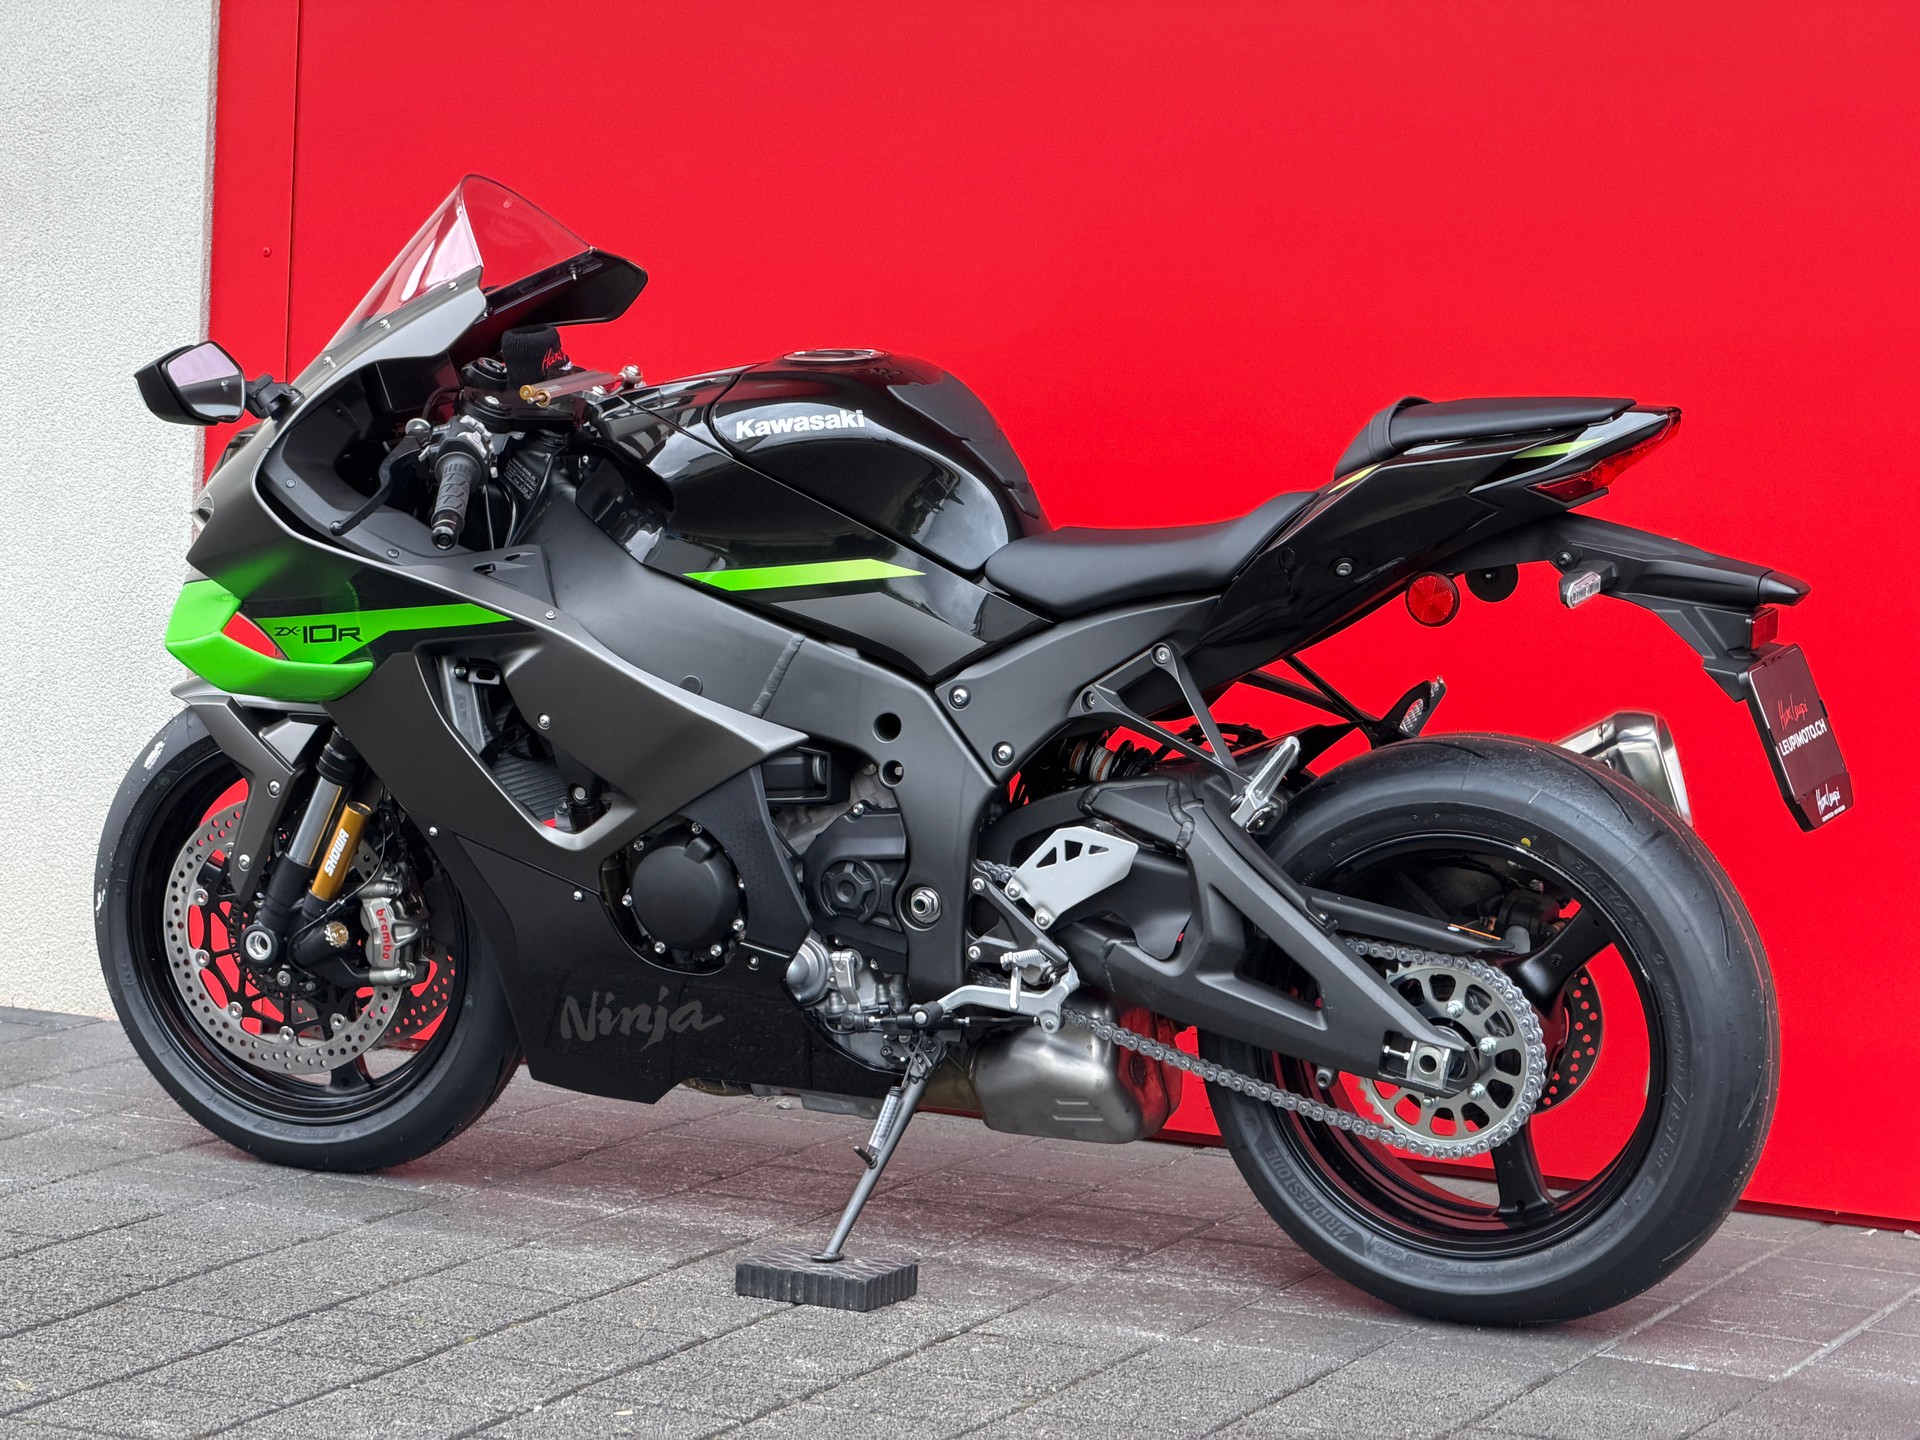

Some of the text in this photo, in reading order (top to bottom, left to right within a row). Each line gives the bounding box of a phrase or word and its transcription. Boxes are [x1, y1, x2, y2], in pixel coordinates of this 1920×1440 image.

[736, 409, 866, 440] Kawasaki
[273, 624, 364, 644] ZX-10R
[1778, 718, 1828, 757] LEUPIMOTO.CH
[324, 827, 350, 878] SHOWA
[375, 907, 395, 961] brembo
[560, 985, 726, 1053] Ninja
[1263, 1146, 1355, 1242] BRIDGESTONE
